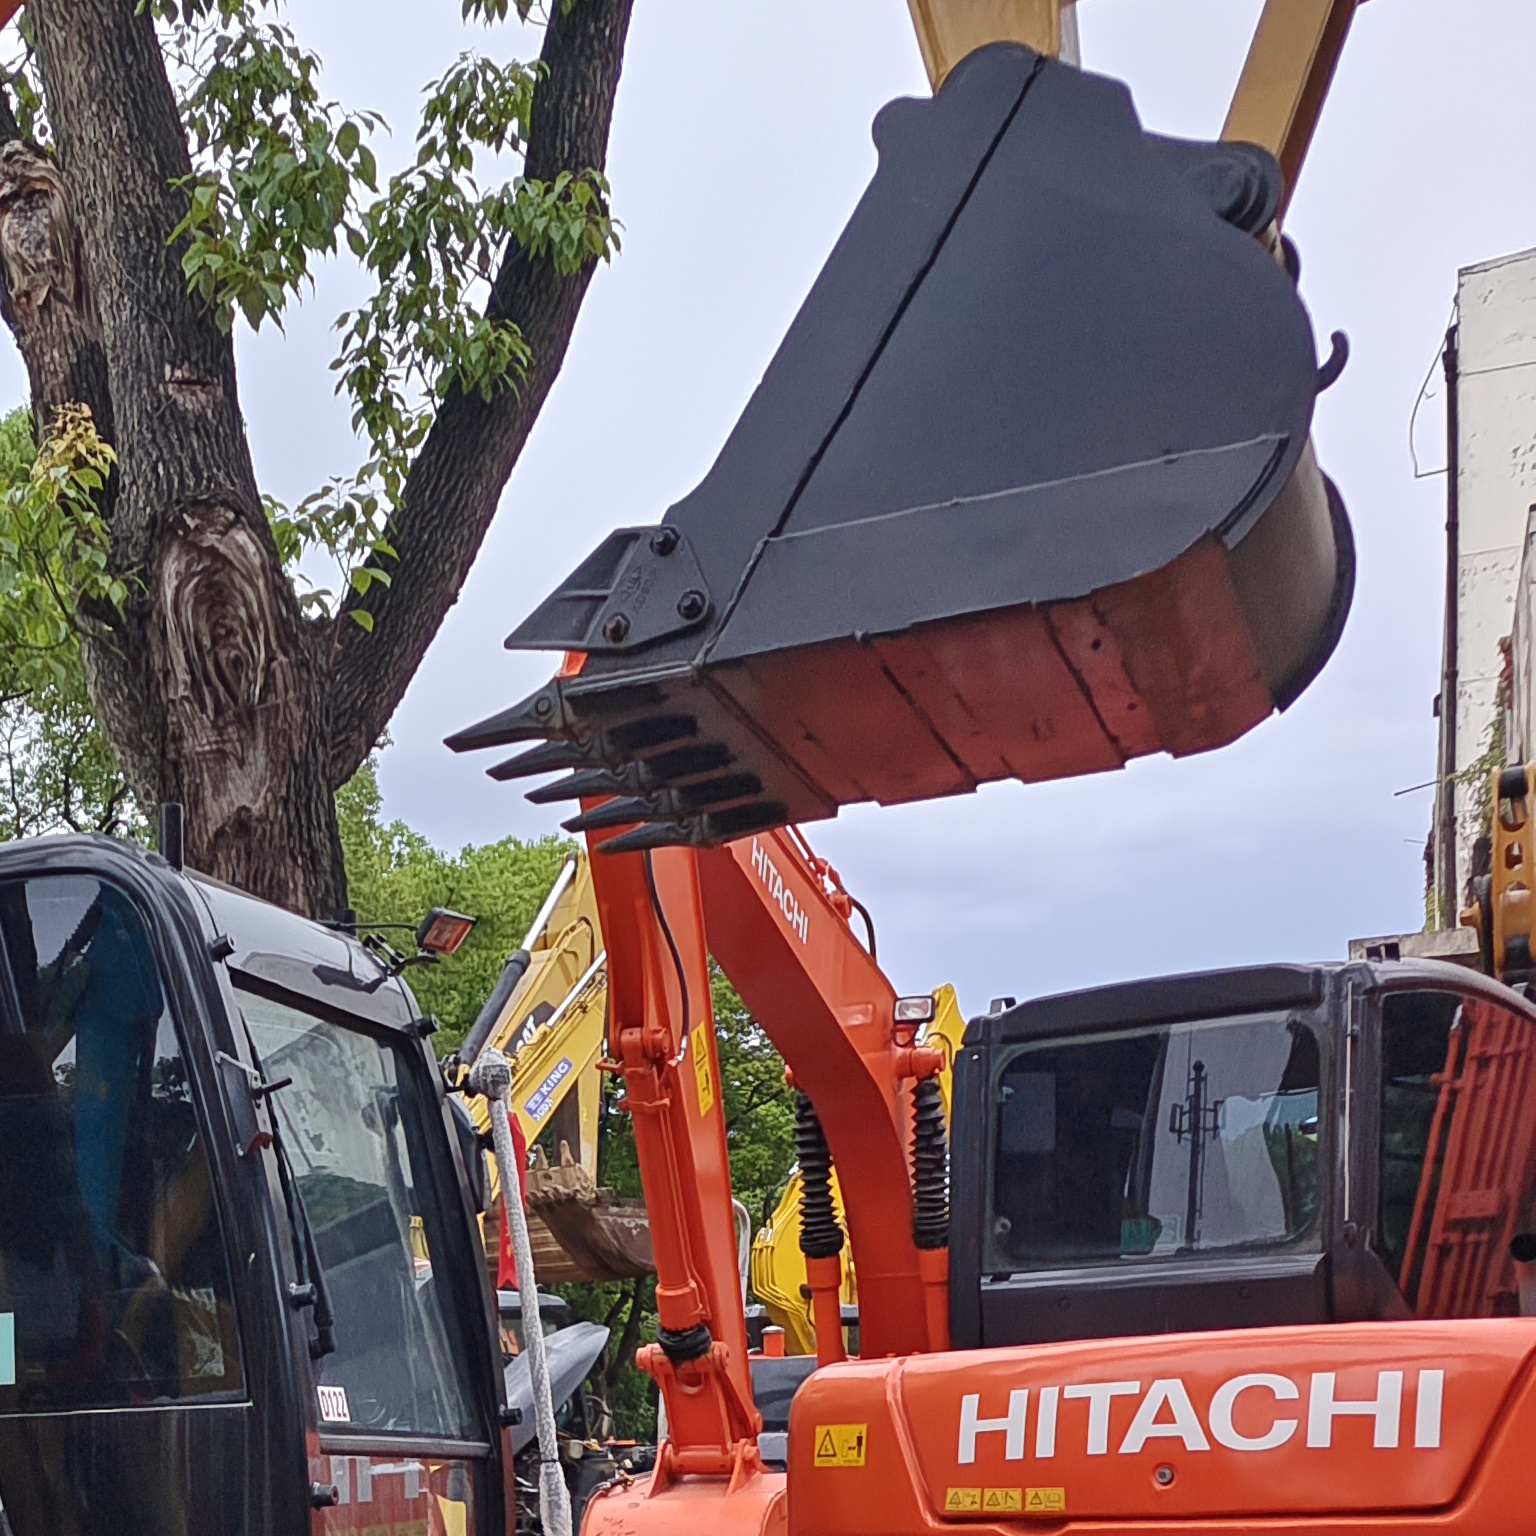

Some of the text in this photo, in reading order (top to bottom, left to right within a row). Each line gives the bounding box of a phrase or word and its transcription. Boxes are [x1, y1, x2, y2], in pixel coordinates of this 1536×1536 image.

[751, 835, 810, 944] HITACHI
[539, 1061, 569, 1096] KING
[957, 1368, 1444, 1464] HITACHI
